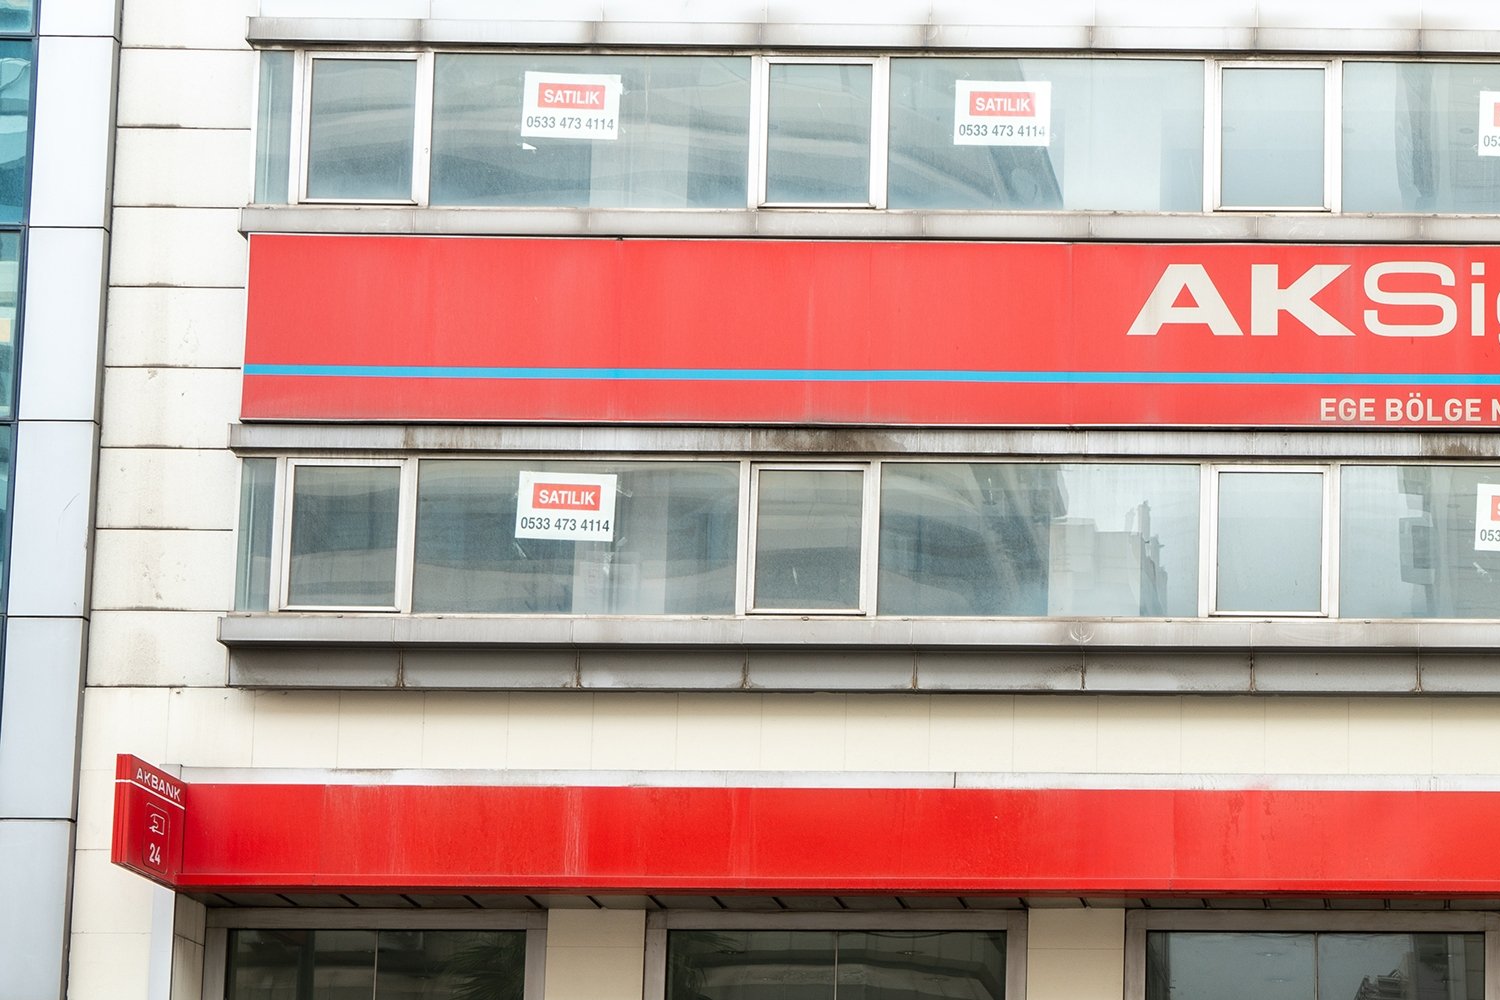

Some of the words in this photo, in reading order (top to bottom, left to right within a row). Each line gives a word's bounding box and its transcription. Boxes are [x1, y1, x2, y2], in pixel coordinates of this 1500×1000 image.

[544, 89, 599, 105] SATILIK
[975, 97, 1031, 112] SATILIK
[527, 116, 556, 128] 0533
[560, 117, 581, 129] 473
[585, 118, 614, 130] 4114
[958, 124, 988, 136] 0533
[992, 124, 1013, 136] 473
[1018, 125, 1045, 137] 4114
[1320, 398, 1376, 422] EGE
[1385, 392, 1481, 422] BÖLGE
[539, 489, 595, 505] SATILIK
[520, 517, 550, 530] 0533
[554, 518, 577, 530] 473
[580, 519, 609, 532] 4114
[136, 767, 181, 801] AKBANK
[149, 842, 161, 866] 24
